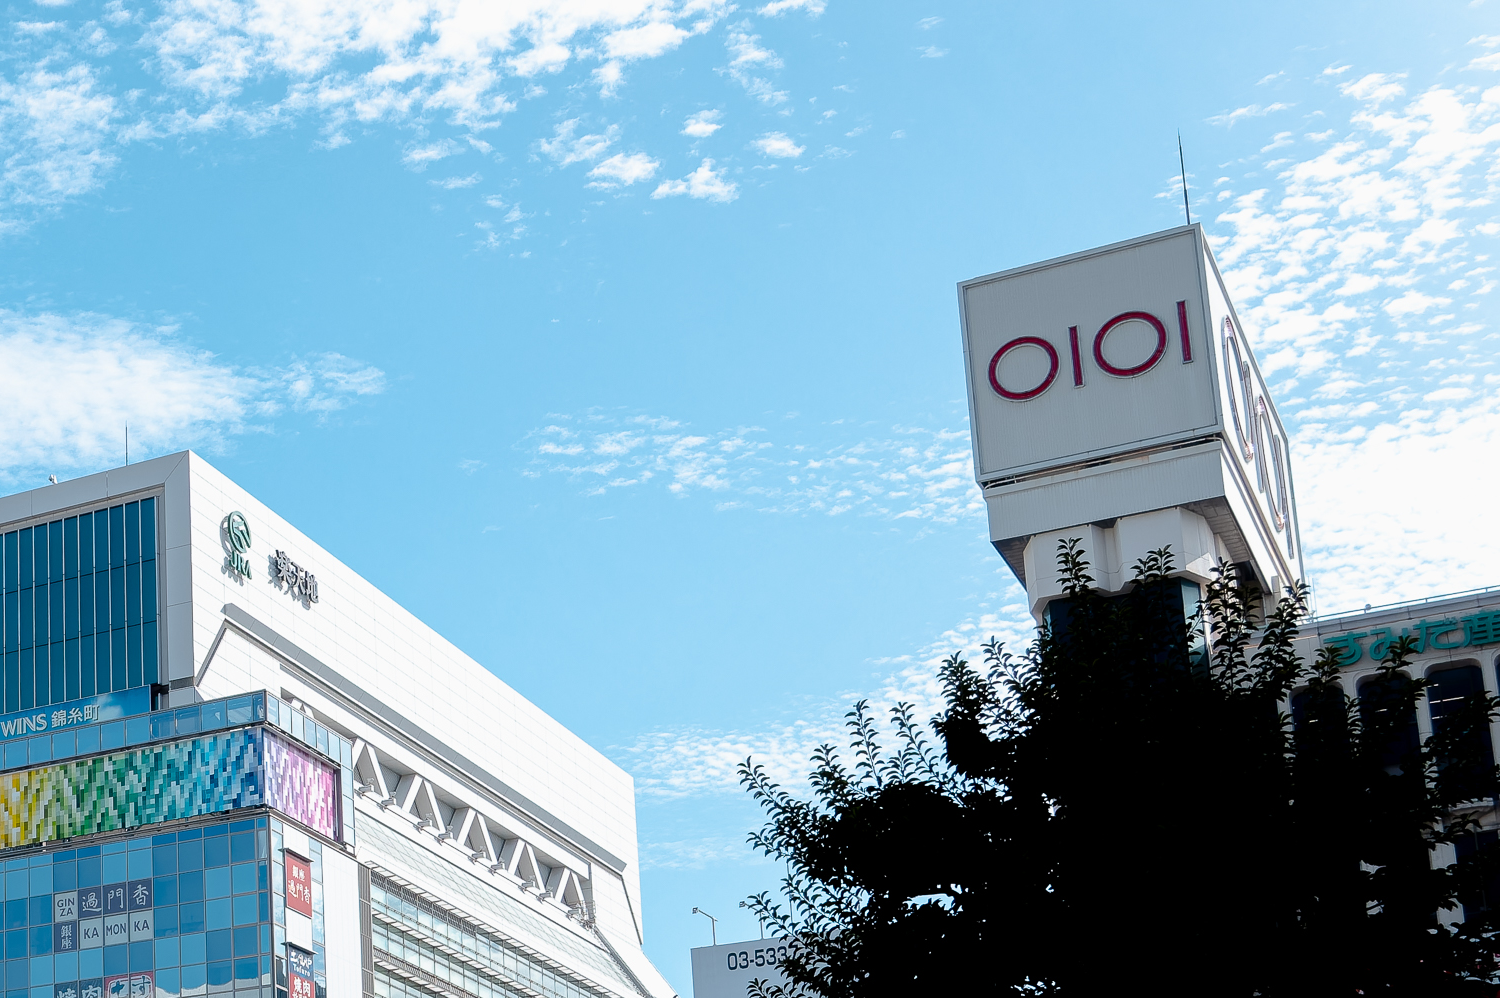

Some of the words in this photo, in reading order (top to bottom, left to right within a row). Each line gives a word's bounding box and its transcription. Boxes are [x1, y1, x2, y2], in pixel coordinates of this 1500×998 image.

[0, 713, 48, 738] WINS
[51, 703, 100, 729] 錦糸町
[56, 897, 75, 908] GIN
[81, 884, 149, 912] 過門香
[59, 908, 74, 918] ZA
[60, 924, 73, 950] 銀座
[83, 927, 100, 940] KA
[105, 922, 127, 937] MON
[133, 919, 150, 933] KA
